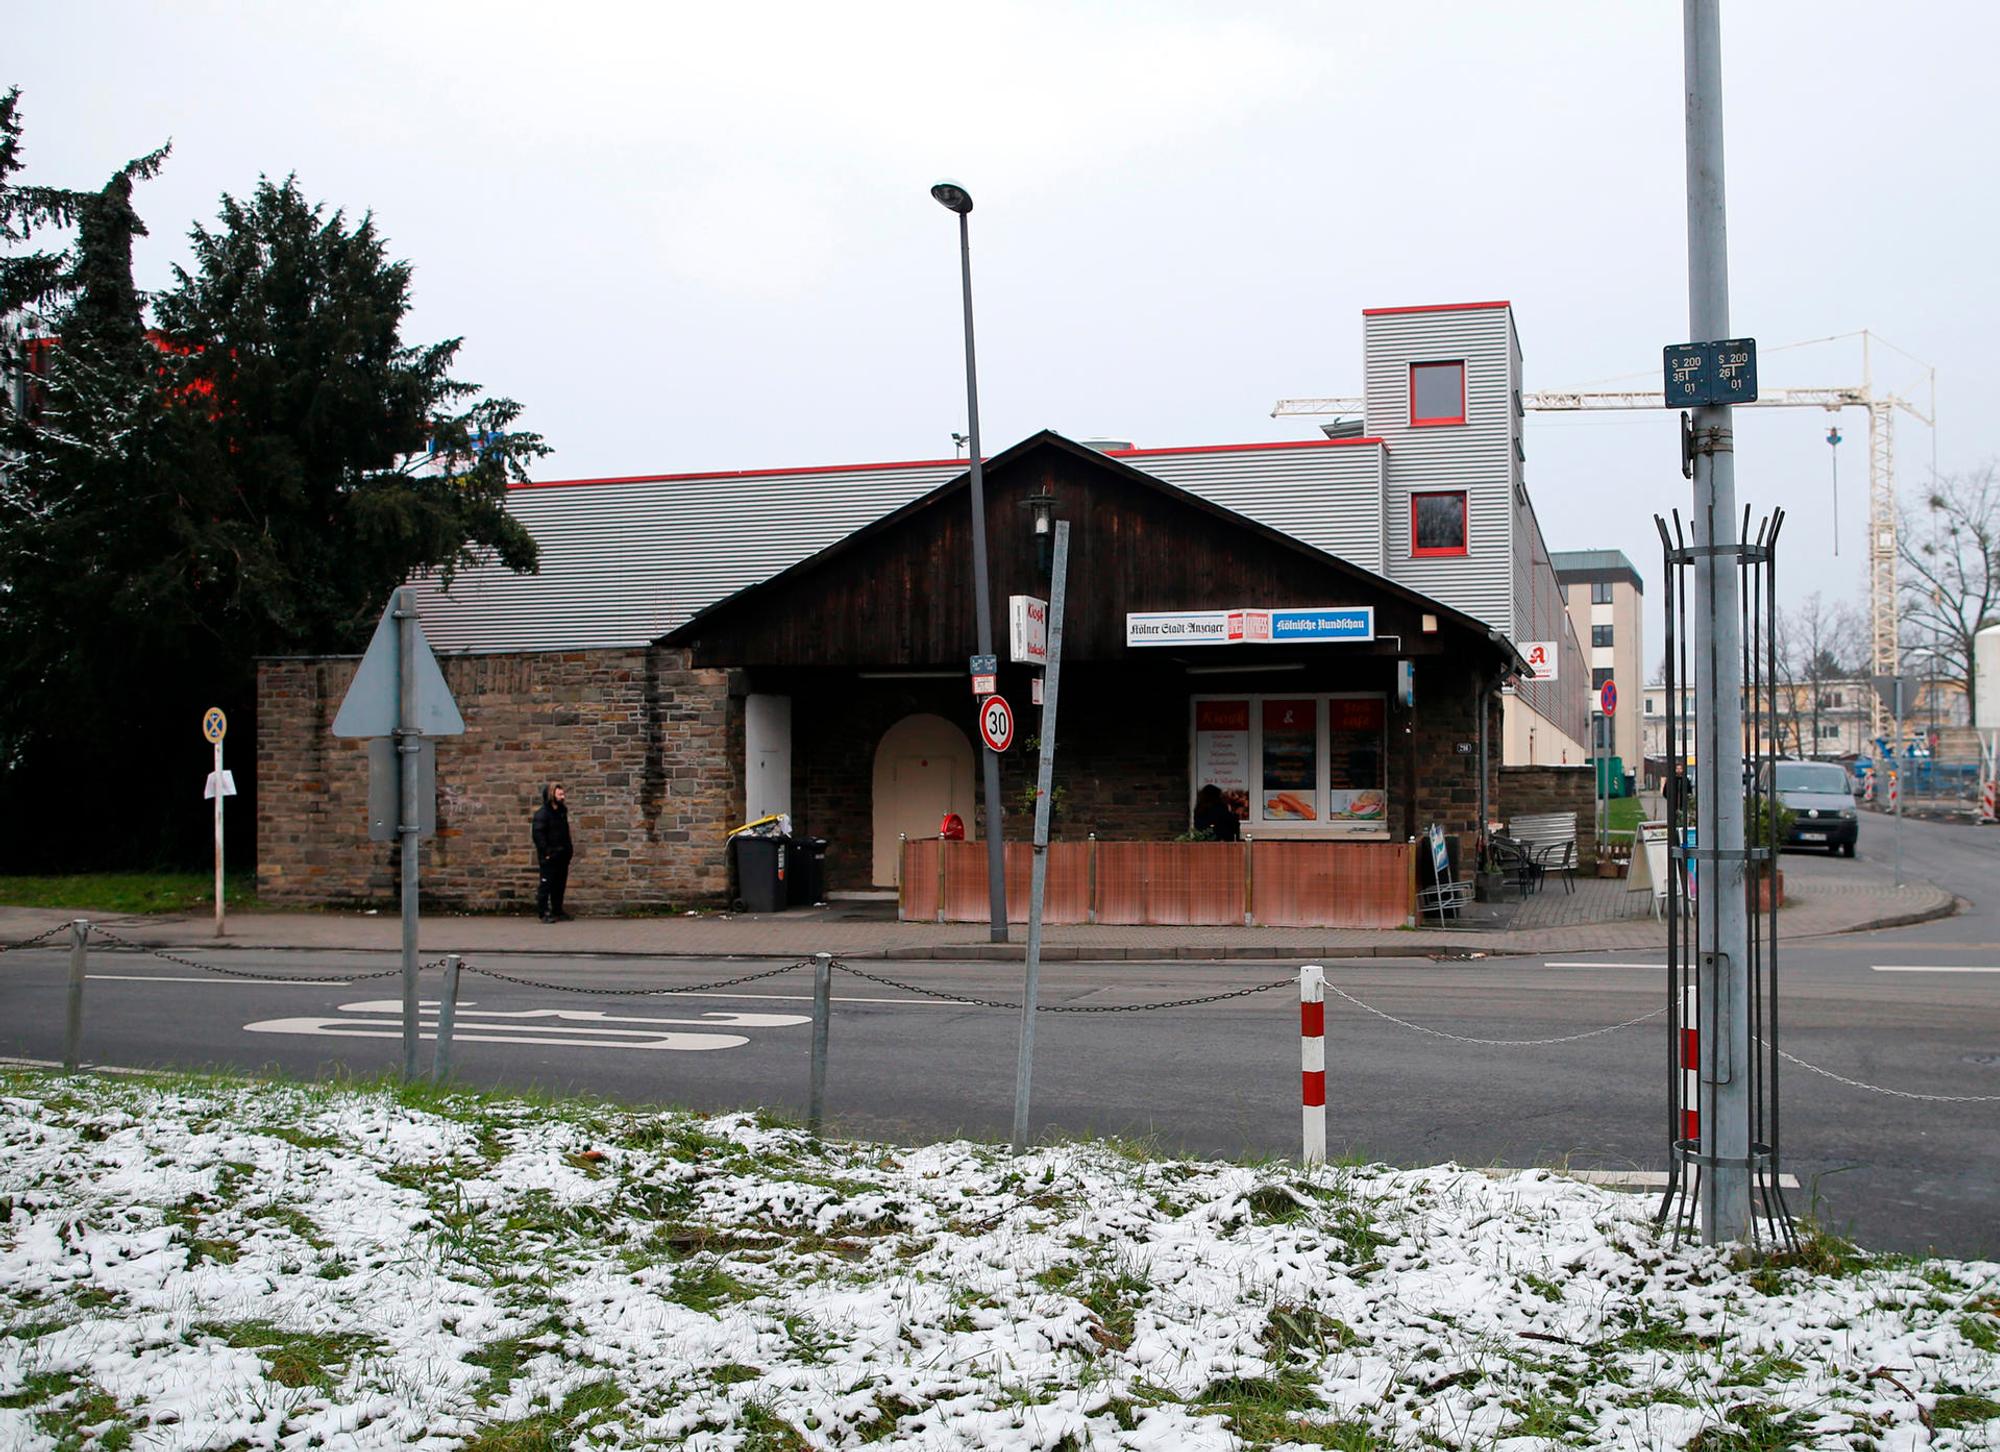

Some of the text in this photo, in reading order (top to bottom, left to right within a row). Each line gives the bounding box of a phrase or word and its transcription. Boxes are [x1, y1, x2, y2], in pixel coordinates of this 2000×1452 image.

[1672, 357, 1701, 368] S 200
[1718, 353, 1748, 364] S 200
[1130, 623, 1160, 635] Kölner
[1161, 622, 1224, 634] Stadt-Anzeiger
[1277, 619, 1316, 632] Kölnische
[1317, 618, 1365, 631] Rundschau
[989, 711, 1007, 735] 30
